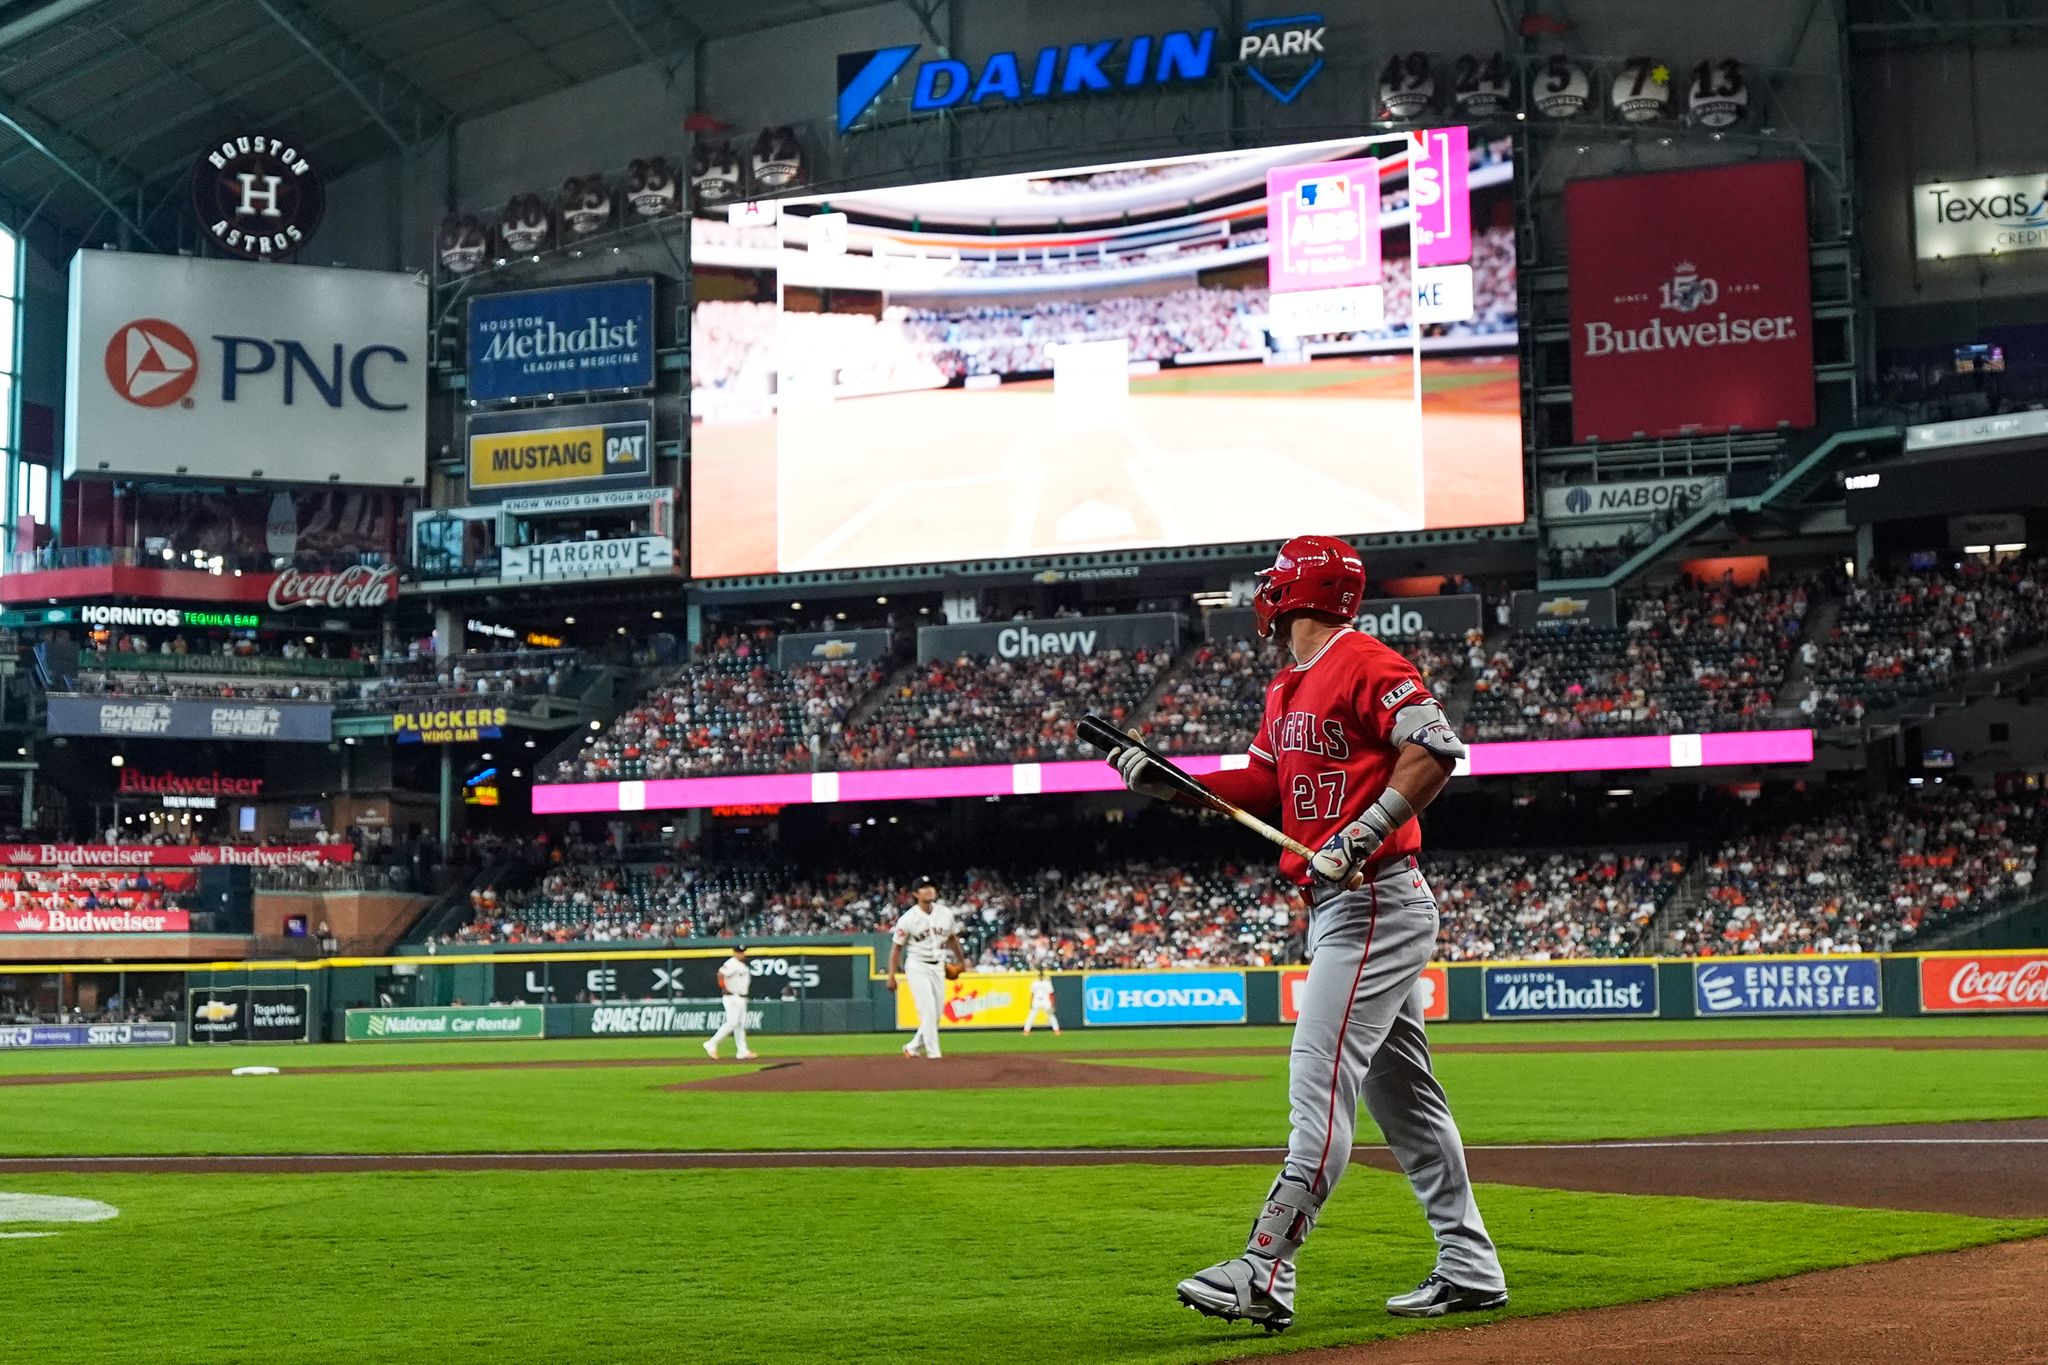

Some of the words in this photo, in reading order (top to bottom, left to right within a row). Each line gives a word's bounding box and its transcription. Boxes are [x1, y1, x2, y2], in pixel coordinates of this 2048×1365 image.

[1239, 27, 1326, 61] PARK
[911, 27, 1218, 112] DAIKIN
[1546, 55, 1572, 93] 5
[1625, 57, 1652, 96] 7
[1692, 58, 1745, 99] 13
[208, 136, 309, 176] HOUSTON
[235, 172, 282, 216] H
[1929, 188, 2029, 223] Texas
[211, 220, 302, 254] ASTROS
[479, 315, 544, 332] HOUSTON
[480, 316, 639, 362] Methodist
[211, 334, 409, 411] PNC
[522, 358, 575, 374] LEADING
[579, 352, 640, 368] MEDICINE
[492, 440, 593, 471] MUSTANG
[605, 435, 645, 464] CAT
[505, 500, 539, 511] KNOW
[544, 496, 580, 508] WHO'S
[584, 495, 600, 505] ON
[604, 492, 633, 503] YOUR
[637, 489, 669, 501] ROOF
[1599, 482, 1704, 509] NABORS
[528, 540, 651, 580] HARGROVE
[1067, 566, 1140, 581] CHEVROLET
[267, 564, 399, 612] Coca-Cola
[81, 605, 181, 628] HORNITOS
[183, 611, 232, 626] TEQUILA
[233, 613, 260, 628] BAR
[997, 626, 1098, 659] Chevy
[100, 703, 157, 719] CHASE
[211, 707, 266, 722] CHASE
[393, 707, 507, 731] PLUCKERS
[122, 717, 172, 734] FIGHT
[233, 720, 282, 736] FIGHT
[421, 729, 454, 743] WING
[455, 728, 479, 742] BAR
[119, 767, 264, 795] Budweiser
[162, 795, 187, 808] BREW
[188, 796, 218, 809] HOUSE
[1293, 770, 1346, 820] 27
[40, 845, 154, 865] Budweiser
[220, 845, 321, 866] Budweiser
[47, 911, 167, 932] Budweiser
[526, 964, 821, 993] LEXS
[749, 958, 789, 977] 370
[1494, 972, 1555, 984] HOUSTON
[1744, 964, 1851, 987] ENERGY
[1117, 988, 1242, 1008] HONDA
[1496, 978, 1644, 1011] Methodist
[1746, 985, 1877, 1008] TRANSFER
[253, 1014, 275, 1027] let's
[385, 1015, 448, 1033] National
[451, 1017, 475, 1032] Car
[475, 1014, 522, 1032] Rental
[591, 1006, 640, 1033] SPACE
[639, 1005, 676, 1032] CITY
[672, 1011, 707, 1031] HOME
